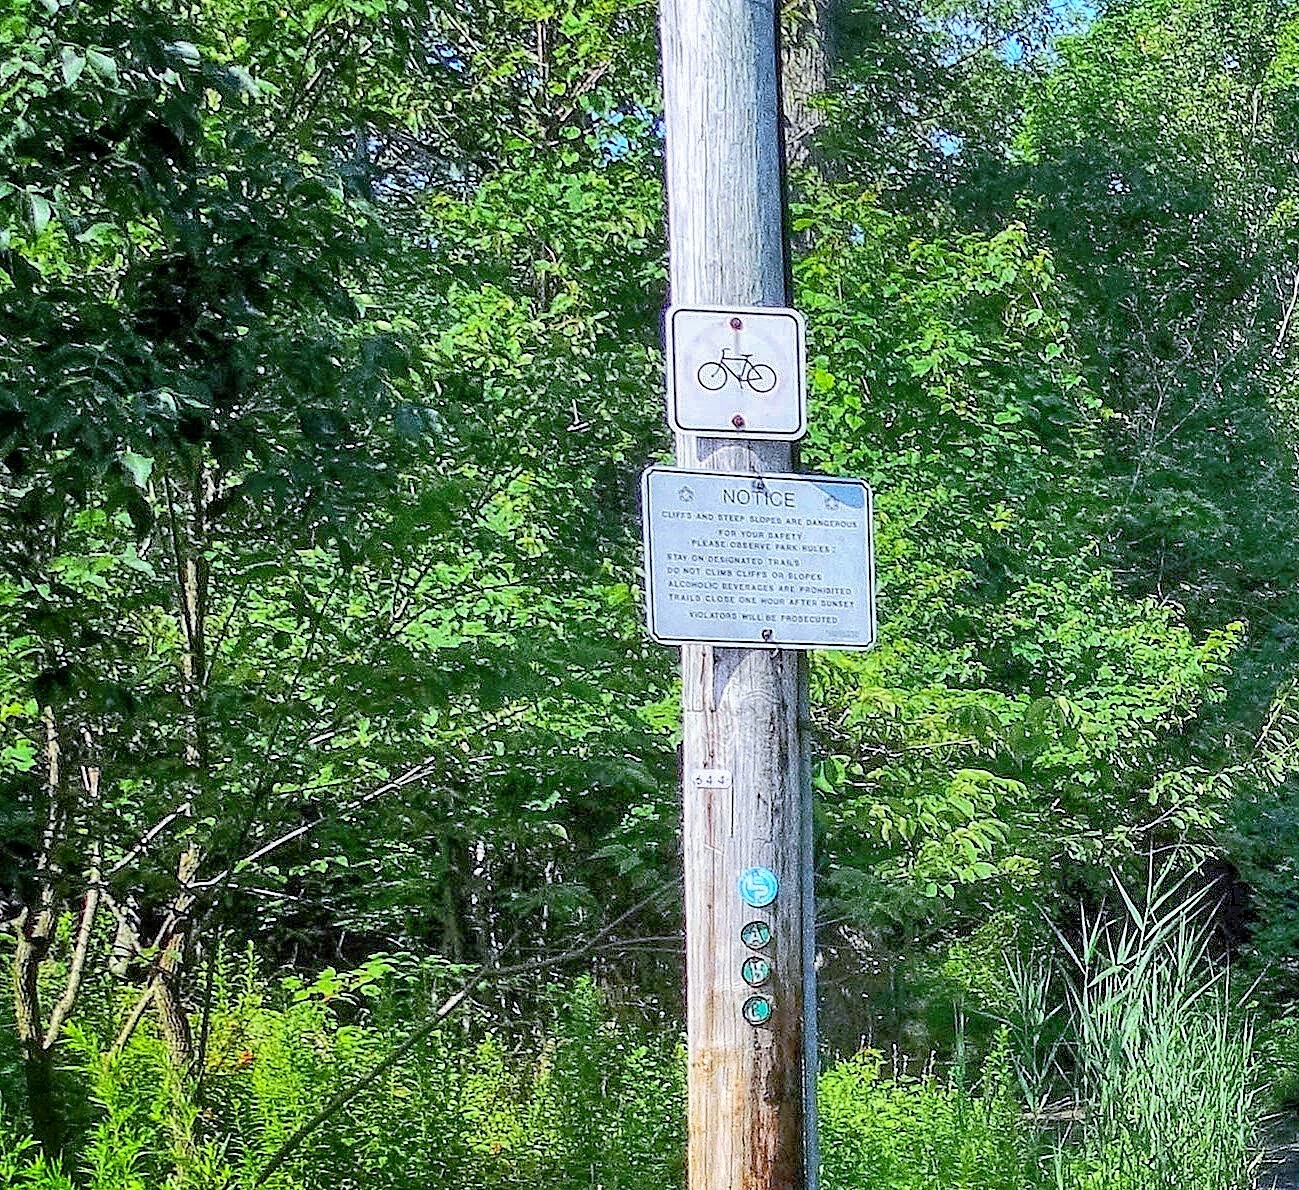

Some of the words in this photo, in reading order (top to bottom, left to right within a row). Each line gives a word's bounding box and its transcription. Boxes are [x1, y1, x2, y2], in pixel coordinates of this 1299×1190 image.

[723, 489, 795, 507] NOTICE
[662, 511, 692, 519] CLIFFS
[696, 513, 714, 521] AND
[718, 514, 744, 522] STEEP
[750, 516, 782, 524] SLOPES
[786, 518, 802, 526] ARE
[806, 519, 858, 528] DANGEROUS
[718, 529, 736, 537] FOR
[741, 530, 764, 538] YOUR
[692, 540, 726, 548] PLEASE
[730, 542, 771, 550] OBSERVE
[708, 556, 763, 565] DESIGNATED
[769, 558, 800, 566] TRAILS
[706, 569, 732, 577] CLIMB
[736, 570, 767, 578] CLIFFS
[788, 573, 822, 581] SLOPES
[668, 581, 718, 590] ALCOHOLIC
[722, 582, 774, 592] BEVERAGES
[800, 586, 851, 595] PROHIBITED
[668, 594, 700, 602] TRAILS
[706, 595, 734, 603] CLOSE
[790, 599, 817, 607] AFTER
[690, 612, 737, 620] VIOLATORS
[742, 613, 763, 621] WILL
[781, 615, 838, 624] PROSECUTED
